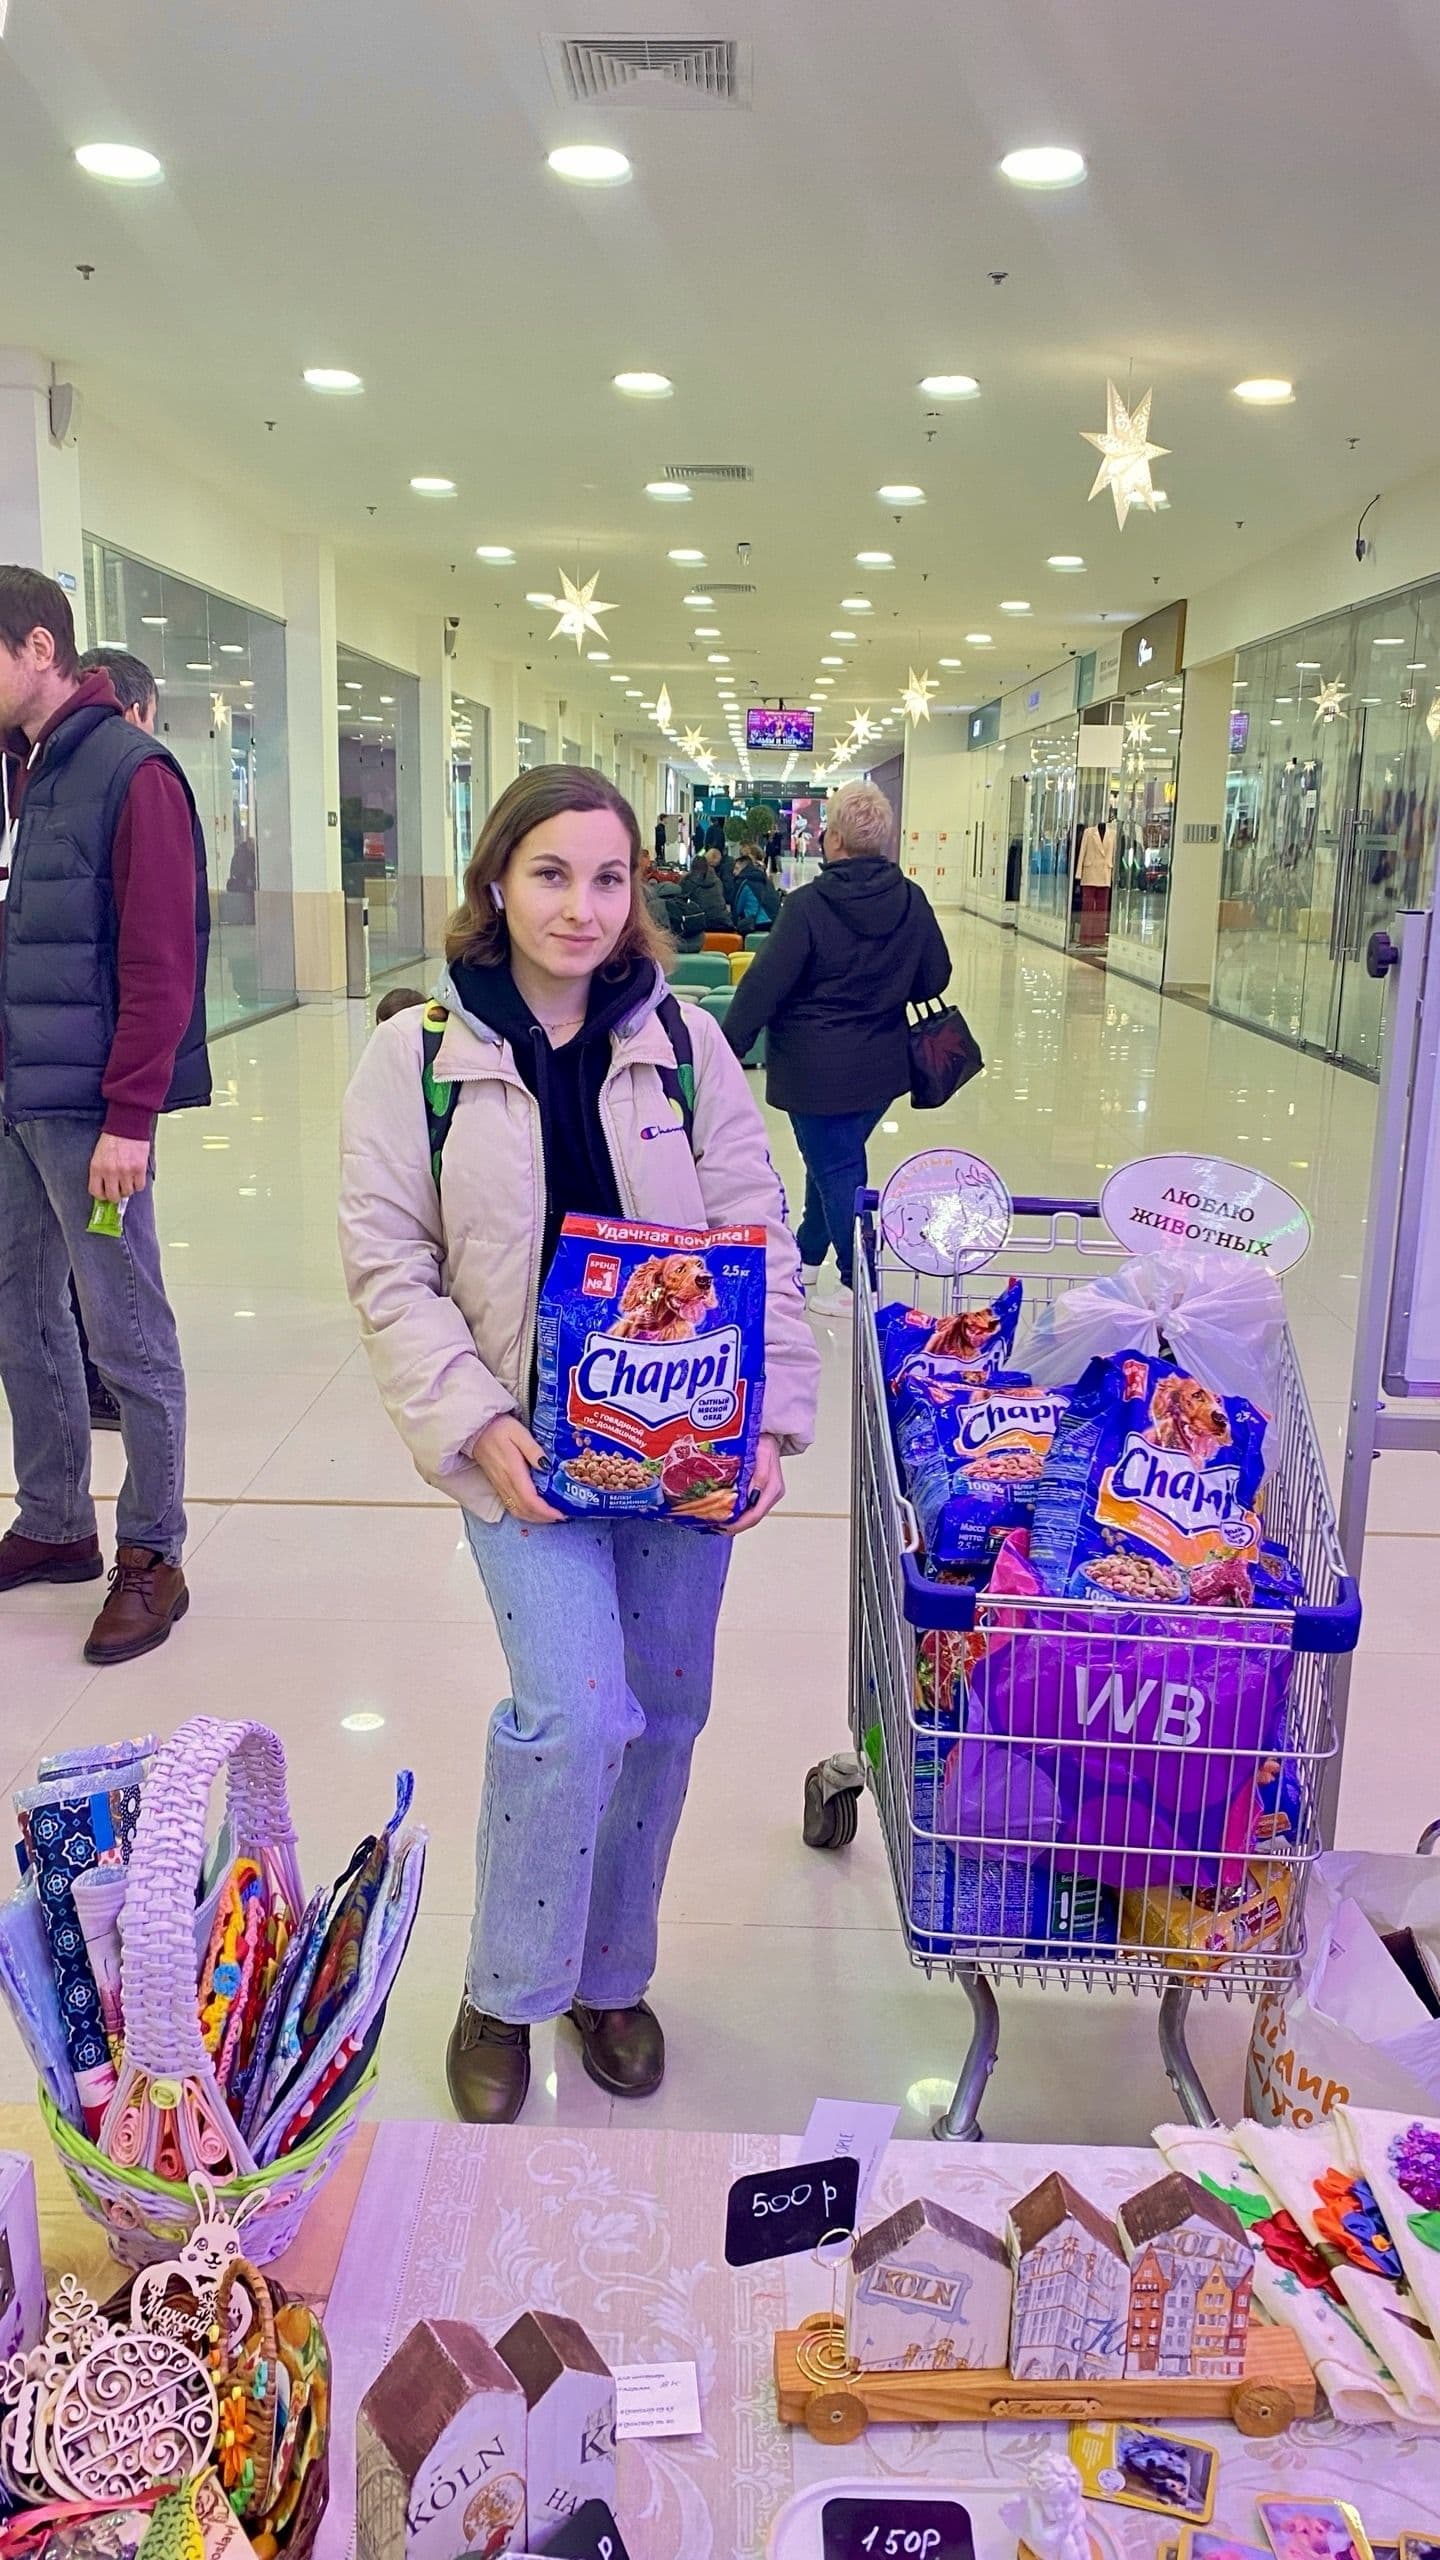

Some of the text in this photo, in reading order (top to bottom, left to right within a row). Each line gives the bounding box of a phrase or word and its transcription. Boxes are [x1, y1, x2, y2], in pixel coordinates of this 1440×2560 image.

[1161, 1187, 1255, 1223] ЛЮБЛЮ
[596, 1222, 750, 1248] Удачная покупка!
[1129, 1207, 1273, 1257] ЖИВОТНЫХ
[578, 1343, 731, 1404] Chappi
[566, 1482, 600, 1503] 100%
[960, 1523, 986, 1533] Масса
[1075, 1665, 1206, 1746] WB
[752, 2184, 812, 2217] 500
[98, 2396, 169, 2448] Вера
[405, 2435, 506, 2537] KÖLN
